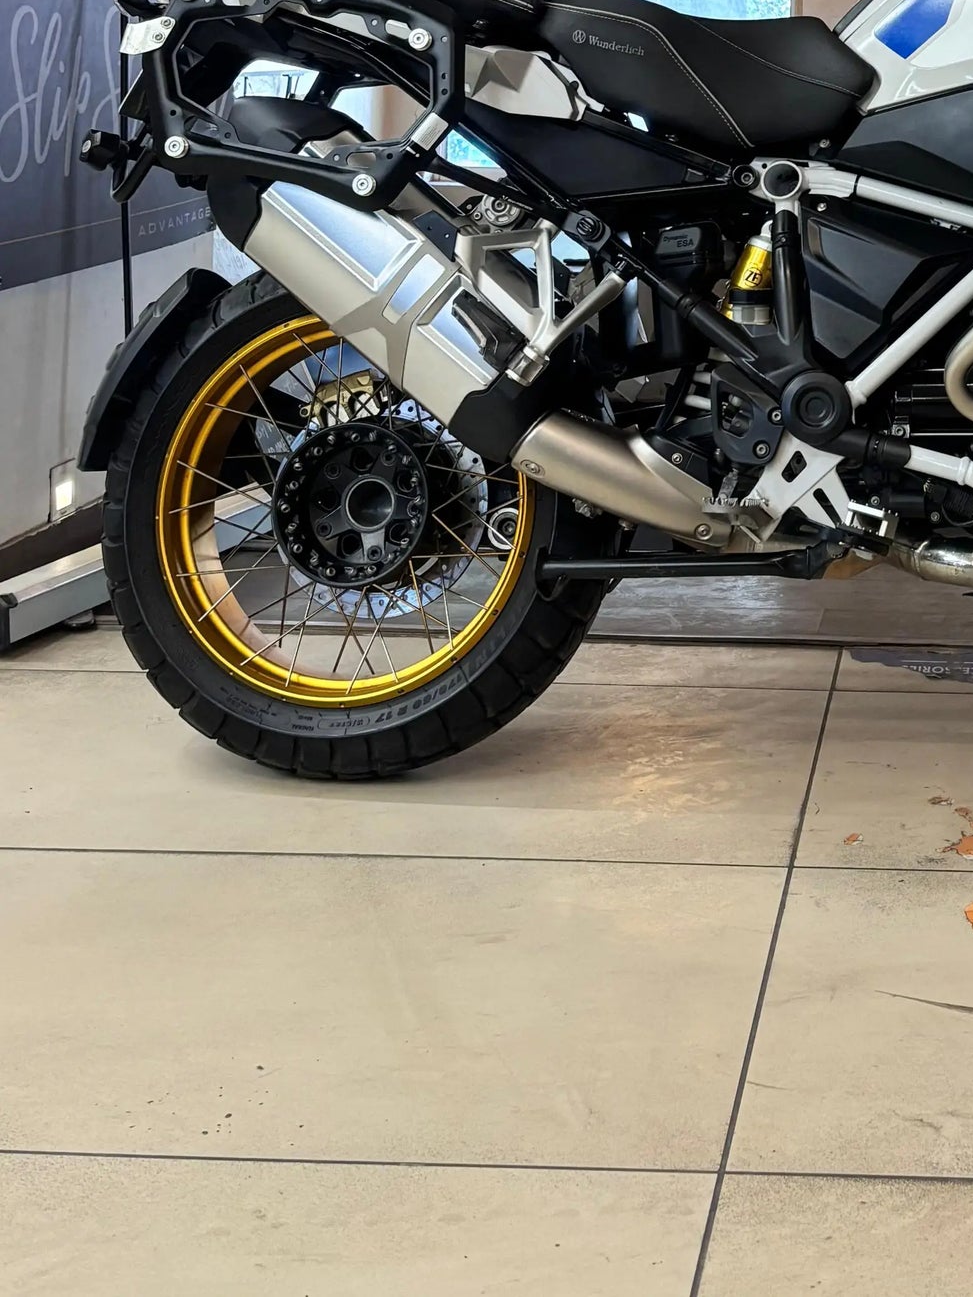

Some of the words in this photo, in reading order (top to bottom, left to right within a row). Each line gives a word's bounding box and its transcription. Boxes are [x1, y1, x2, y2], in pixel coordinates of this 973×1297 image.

[588, 34, 645, 57] Wunderlich
[138, 206, 211, 237] ADVANTAGE
[745, 271, 762, 282] ZF
